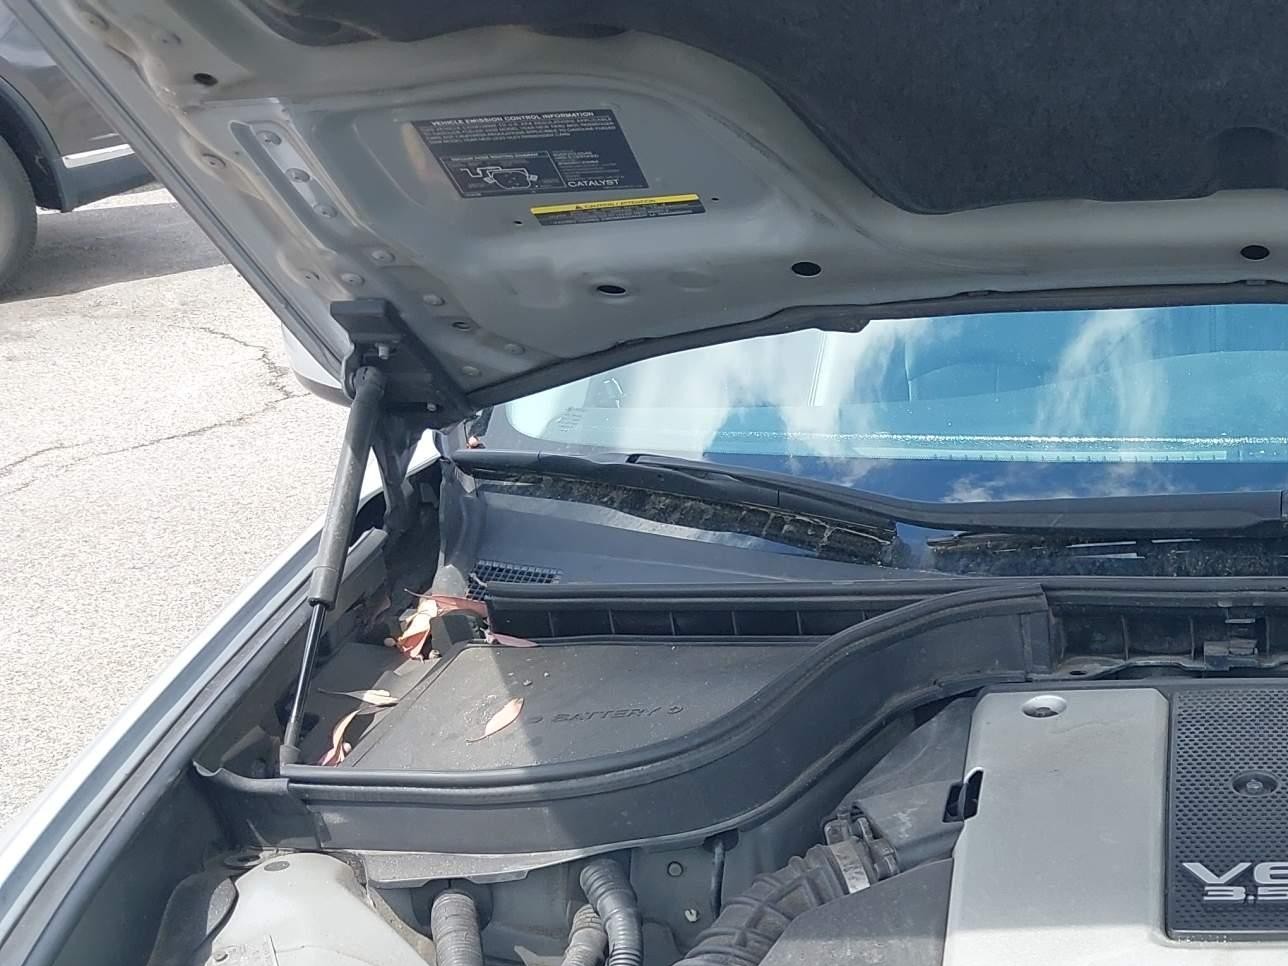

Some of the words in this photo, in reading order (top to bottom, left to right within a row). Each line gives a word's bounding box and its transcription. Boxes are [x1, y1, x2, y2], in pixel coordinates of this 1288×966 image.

[504, 114, 541, 122] CONTROL
[542, 111, 595, 119] INFORMATION
[567, 179, 619, 188] CATALYST
[552, 706, 662, 723] BATTERY
